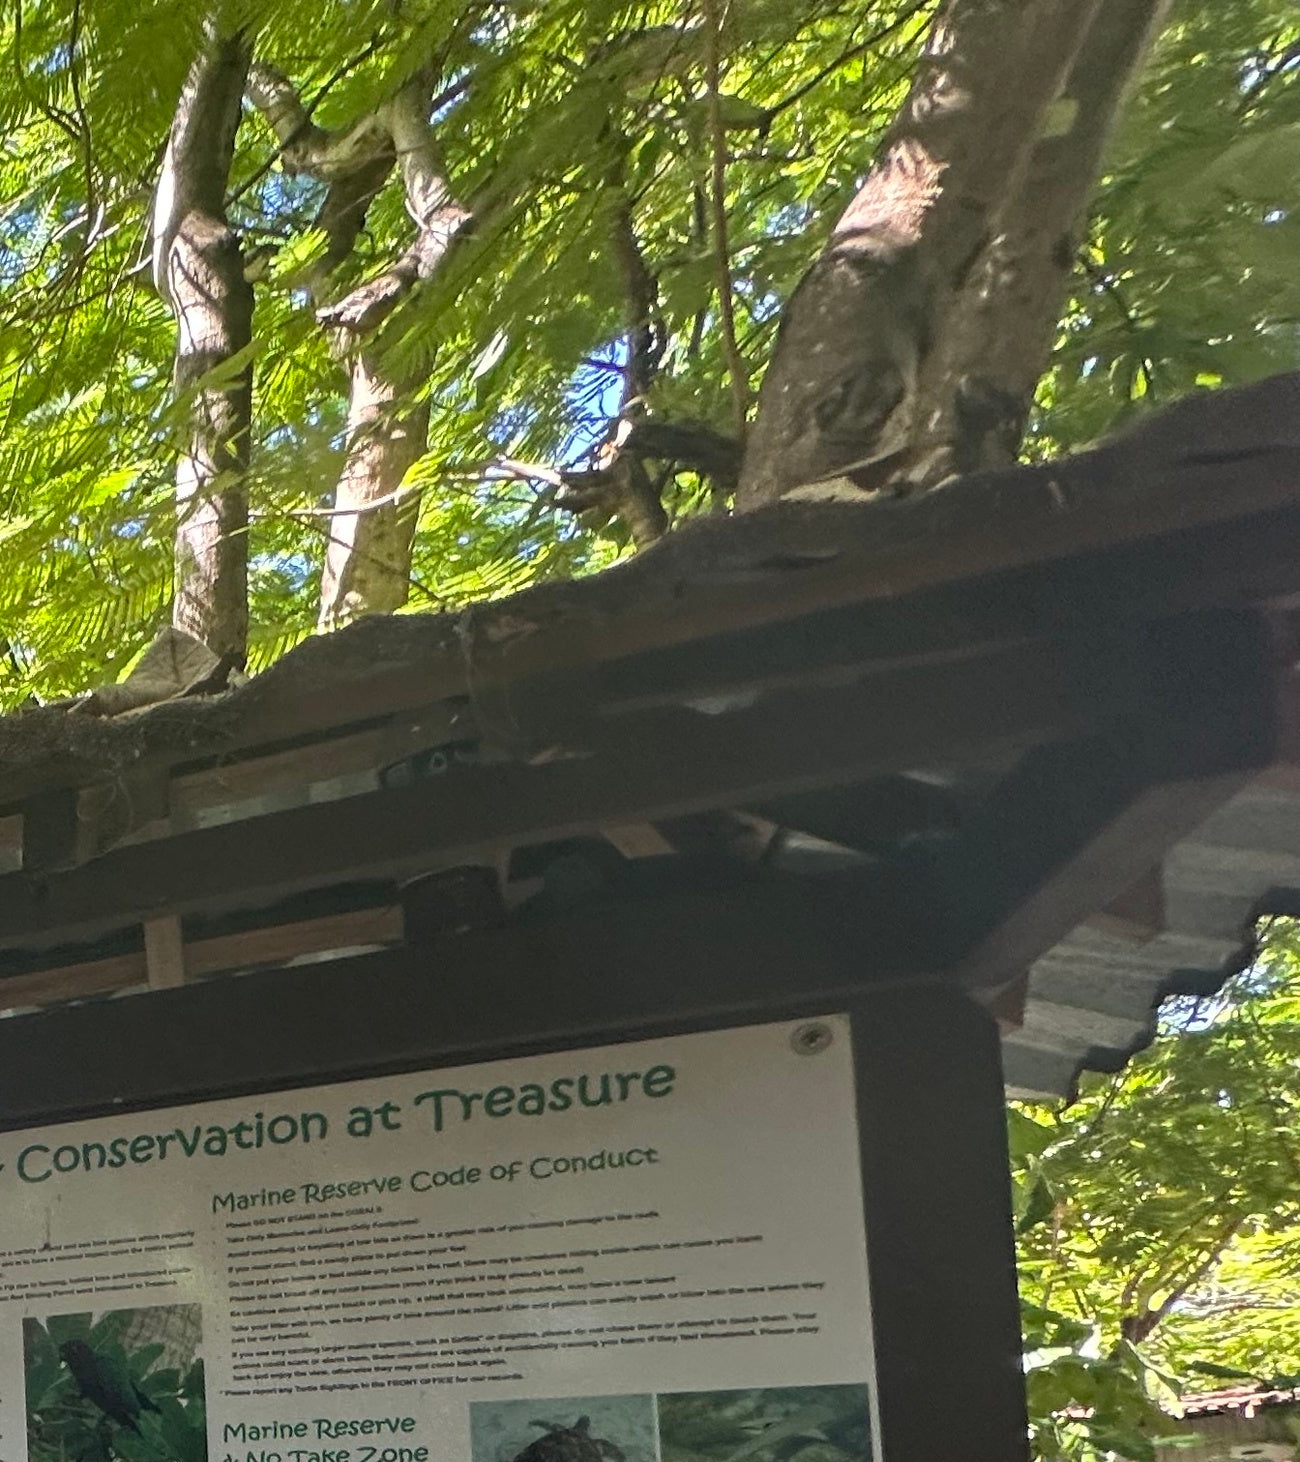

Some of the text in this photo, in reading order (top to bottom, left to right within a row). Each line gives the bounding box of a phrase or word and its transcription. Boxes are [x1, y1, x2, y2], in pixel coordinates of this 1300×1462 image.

[17, 1111, 328, 1184] Conservation
[347, 1101, 402, 1138] at
[415, 1064, 677, 1133] Treasure
[212, 1147, 659, 1214] Marine Reserve Code of Conduct
[223, 1416, 416, 1443] Marine Reserve
